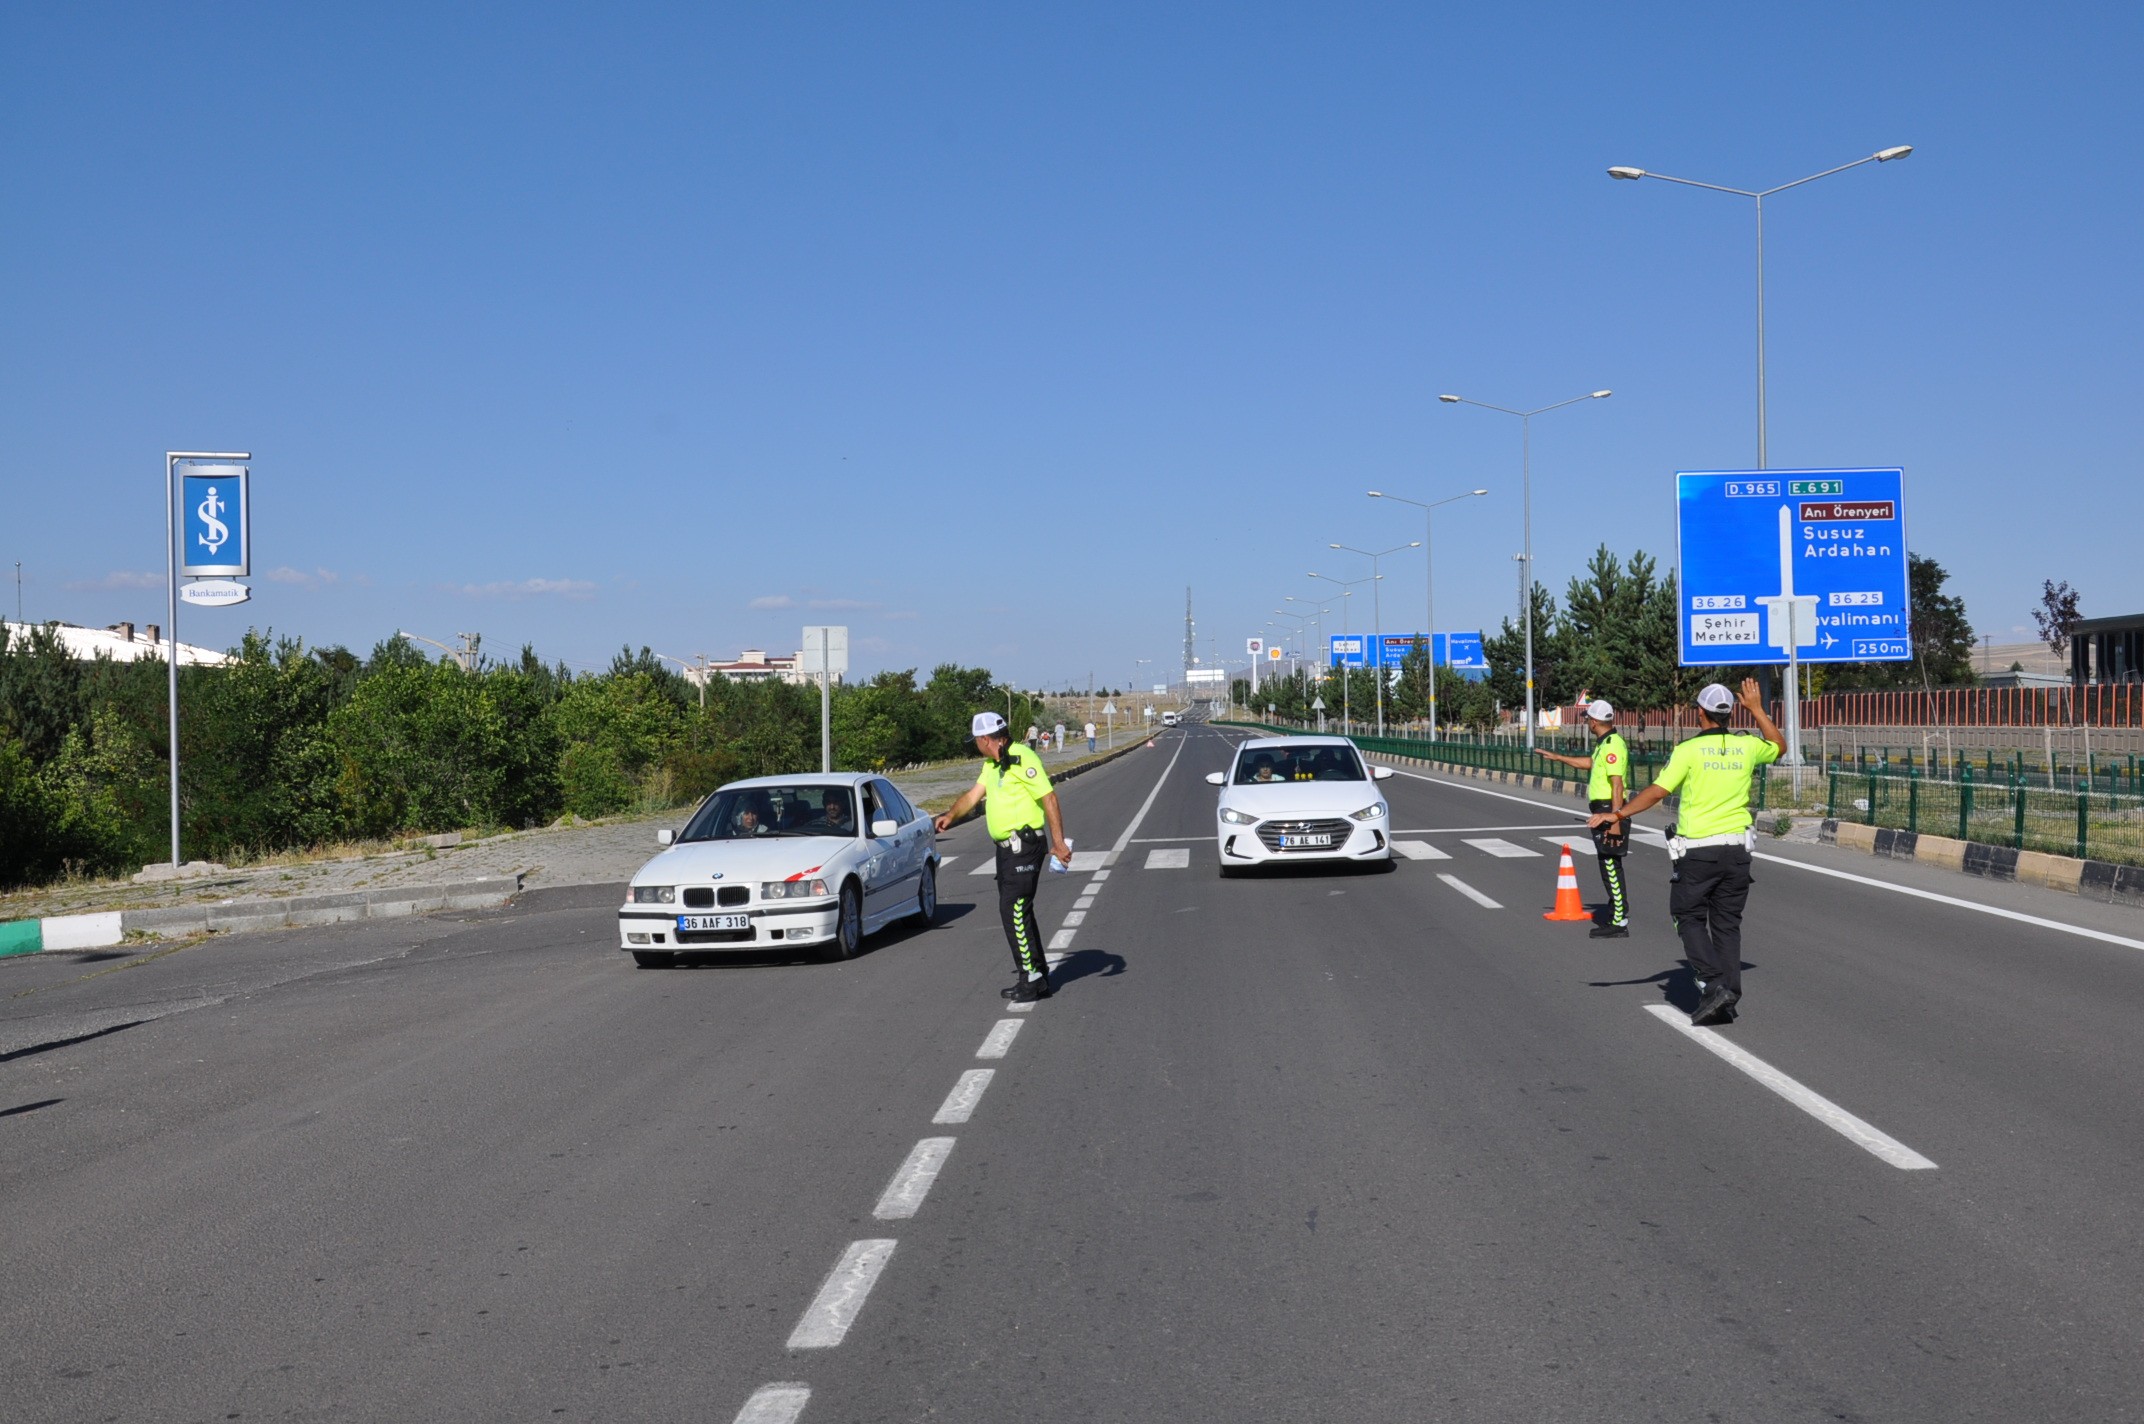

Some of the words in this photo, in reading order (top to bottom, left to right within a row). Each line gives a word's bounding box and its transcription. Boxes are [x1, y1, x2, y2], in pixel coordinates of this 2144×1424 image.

[1729, 484, 1776, 495] D.965
[1792, 482, 1840, 494] E.691
[1804, 507, 1826, 518] Anı
[1833, 504, 1889, 519] Örenyeri
[1803, 526, 1865, 540] Susuz
[1804, 543, 1891, 558] Ardahan
[189, 588, 239, 598] Bankamatik
[1696, 597, 1742, 608] 36.26
[1833, 594, 1880, 604] 36.25
[1704, 618, 1746, 630] Şehir
[1695, 631, 1756, 642] Merkezi
[1858, 643, 1904, 654] 250m
[1285, 837, 1295, 845] 76
[1300, 836, 1310, 845] AE
[685, 919, 698, 929] 36
[702, 918, 721, 928] AAF
[726, 916, 747, 927] 318
